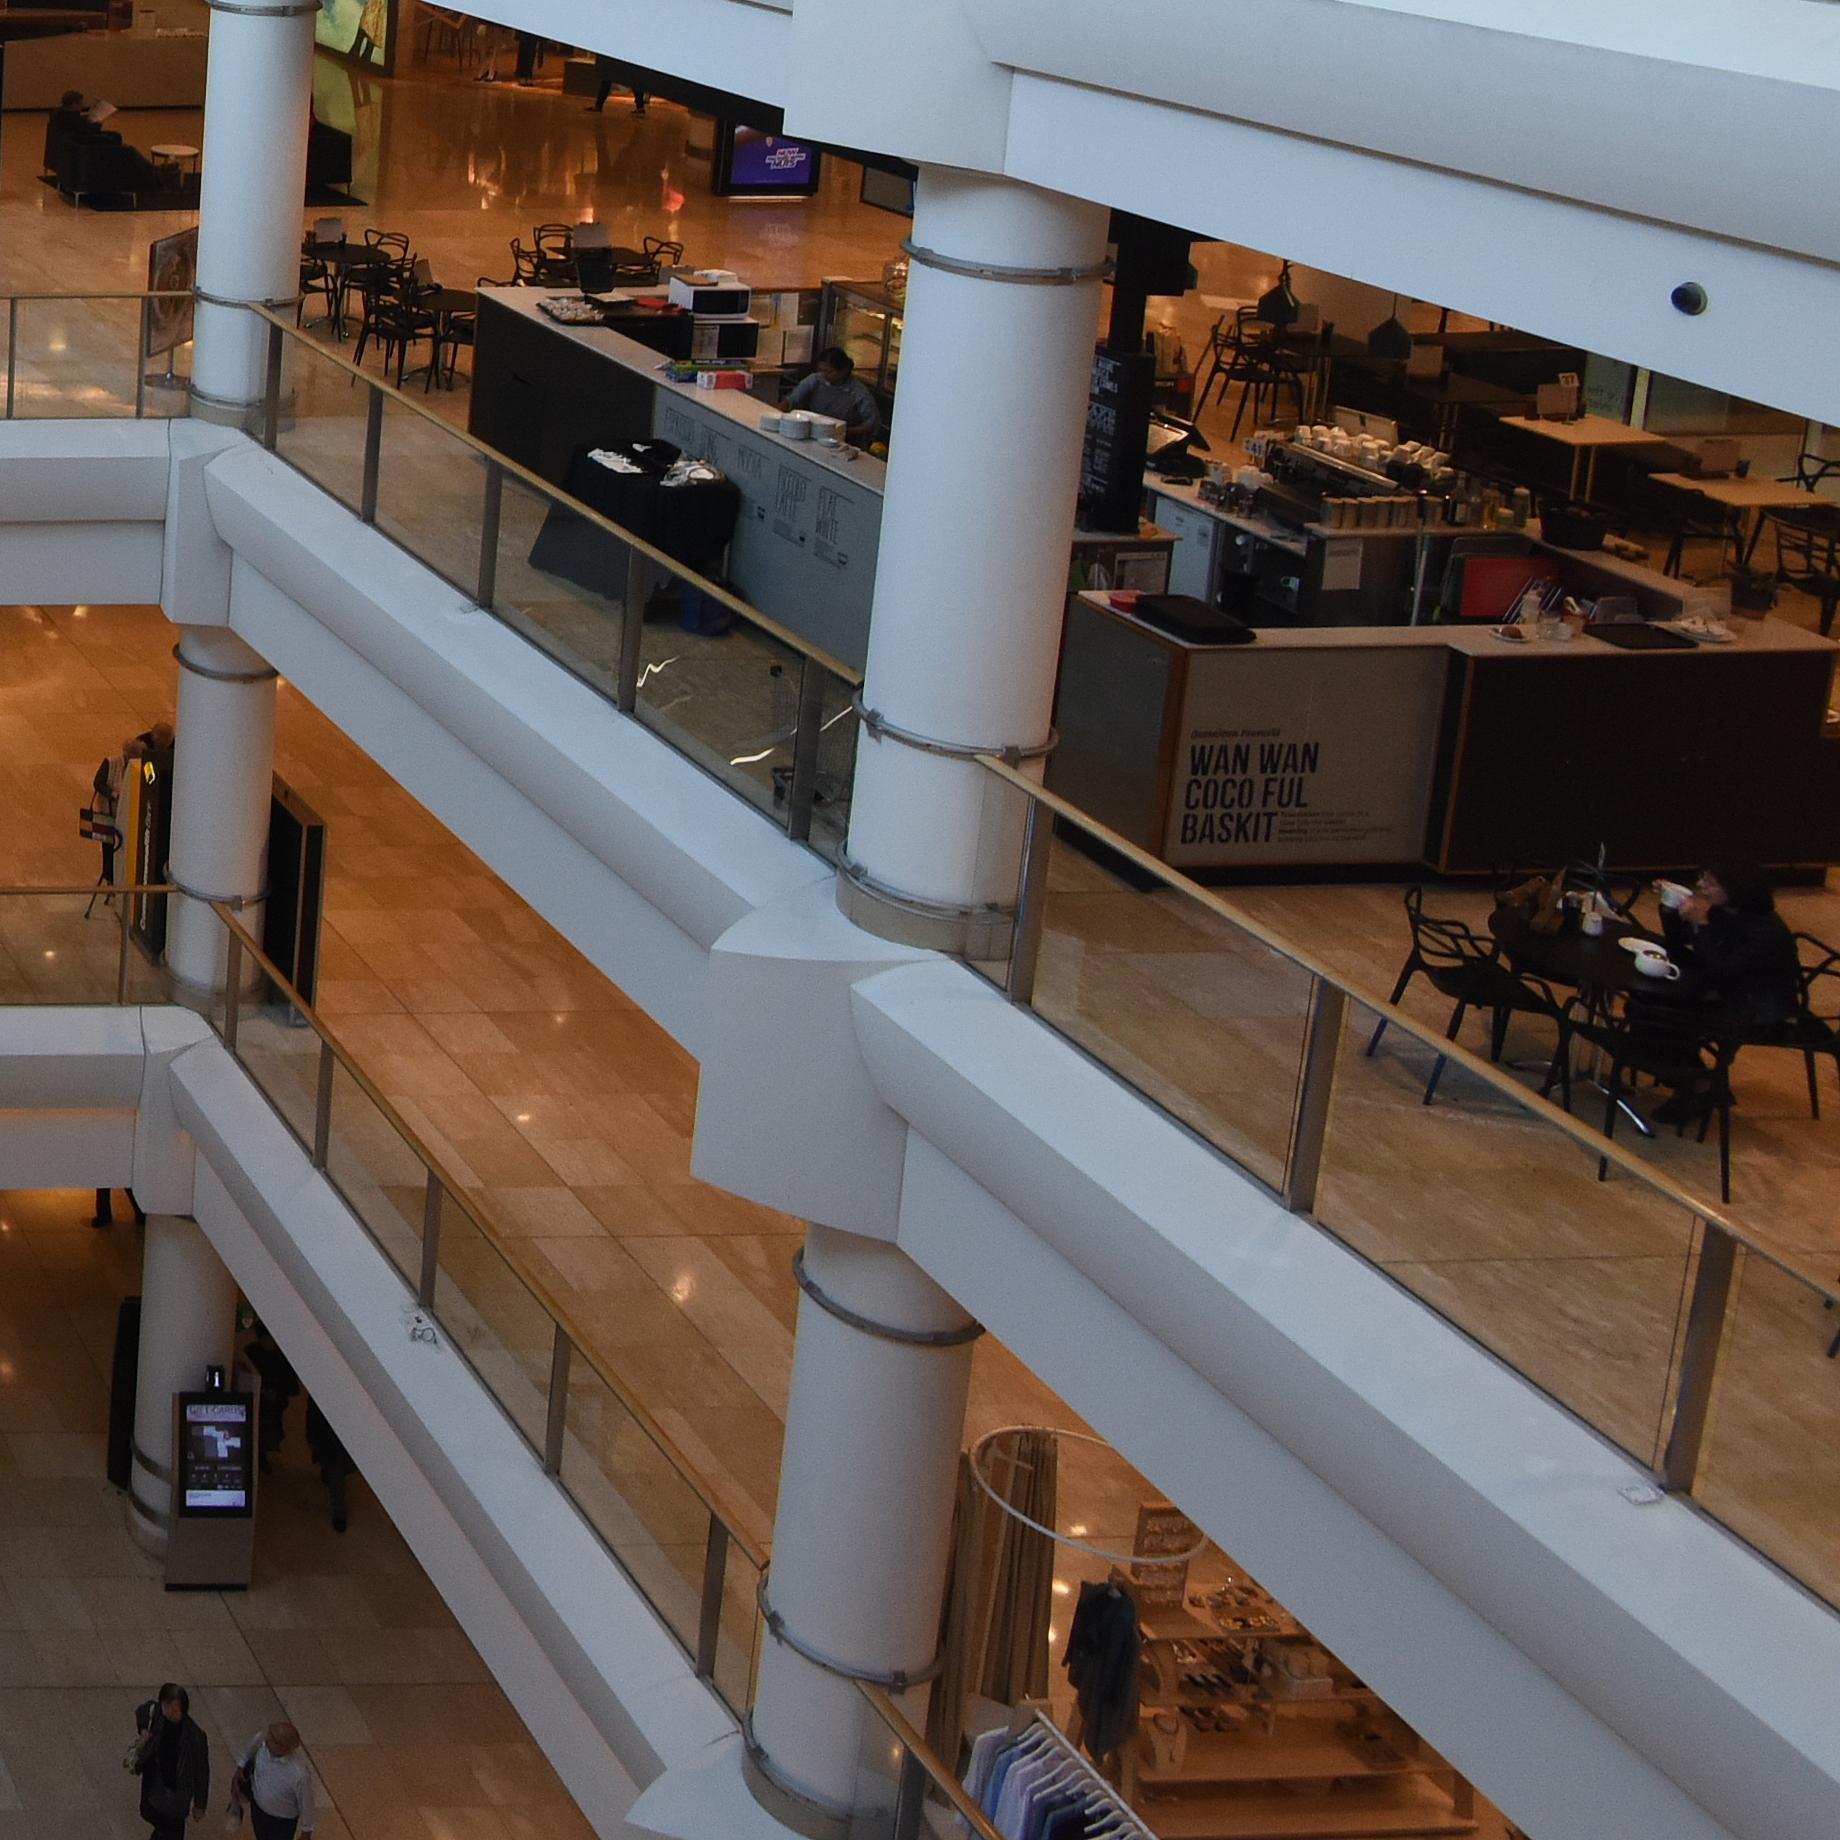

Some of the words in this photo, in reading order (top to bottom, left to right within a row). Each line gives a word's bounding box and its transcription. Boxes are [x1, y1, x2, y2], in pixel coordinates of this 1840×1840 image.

[1190, 743, 1250, 776] WAN
[1260, 742, 1319, 774] WAN
[1185, 778, 1254, 810] COCO
[1262, 777, 1308, 808] FUL
[1180, 812, 1278, 844] BASKIT
